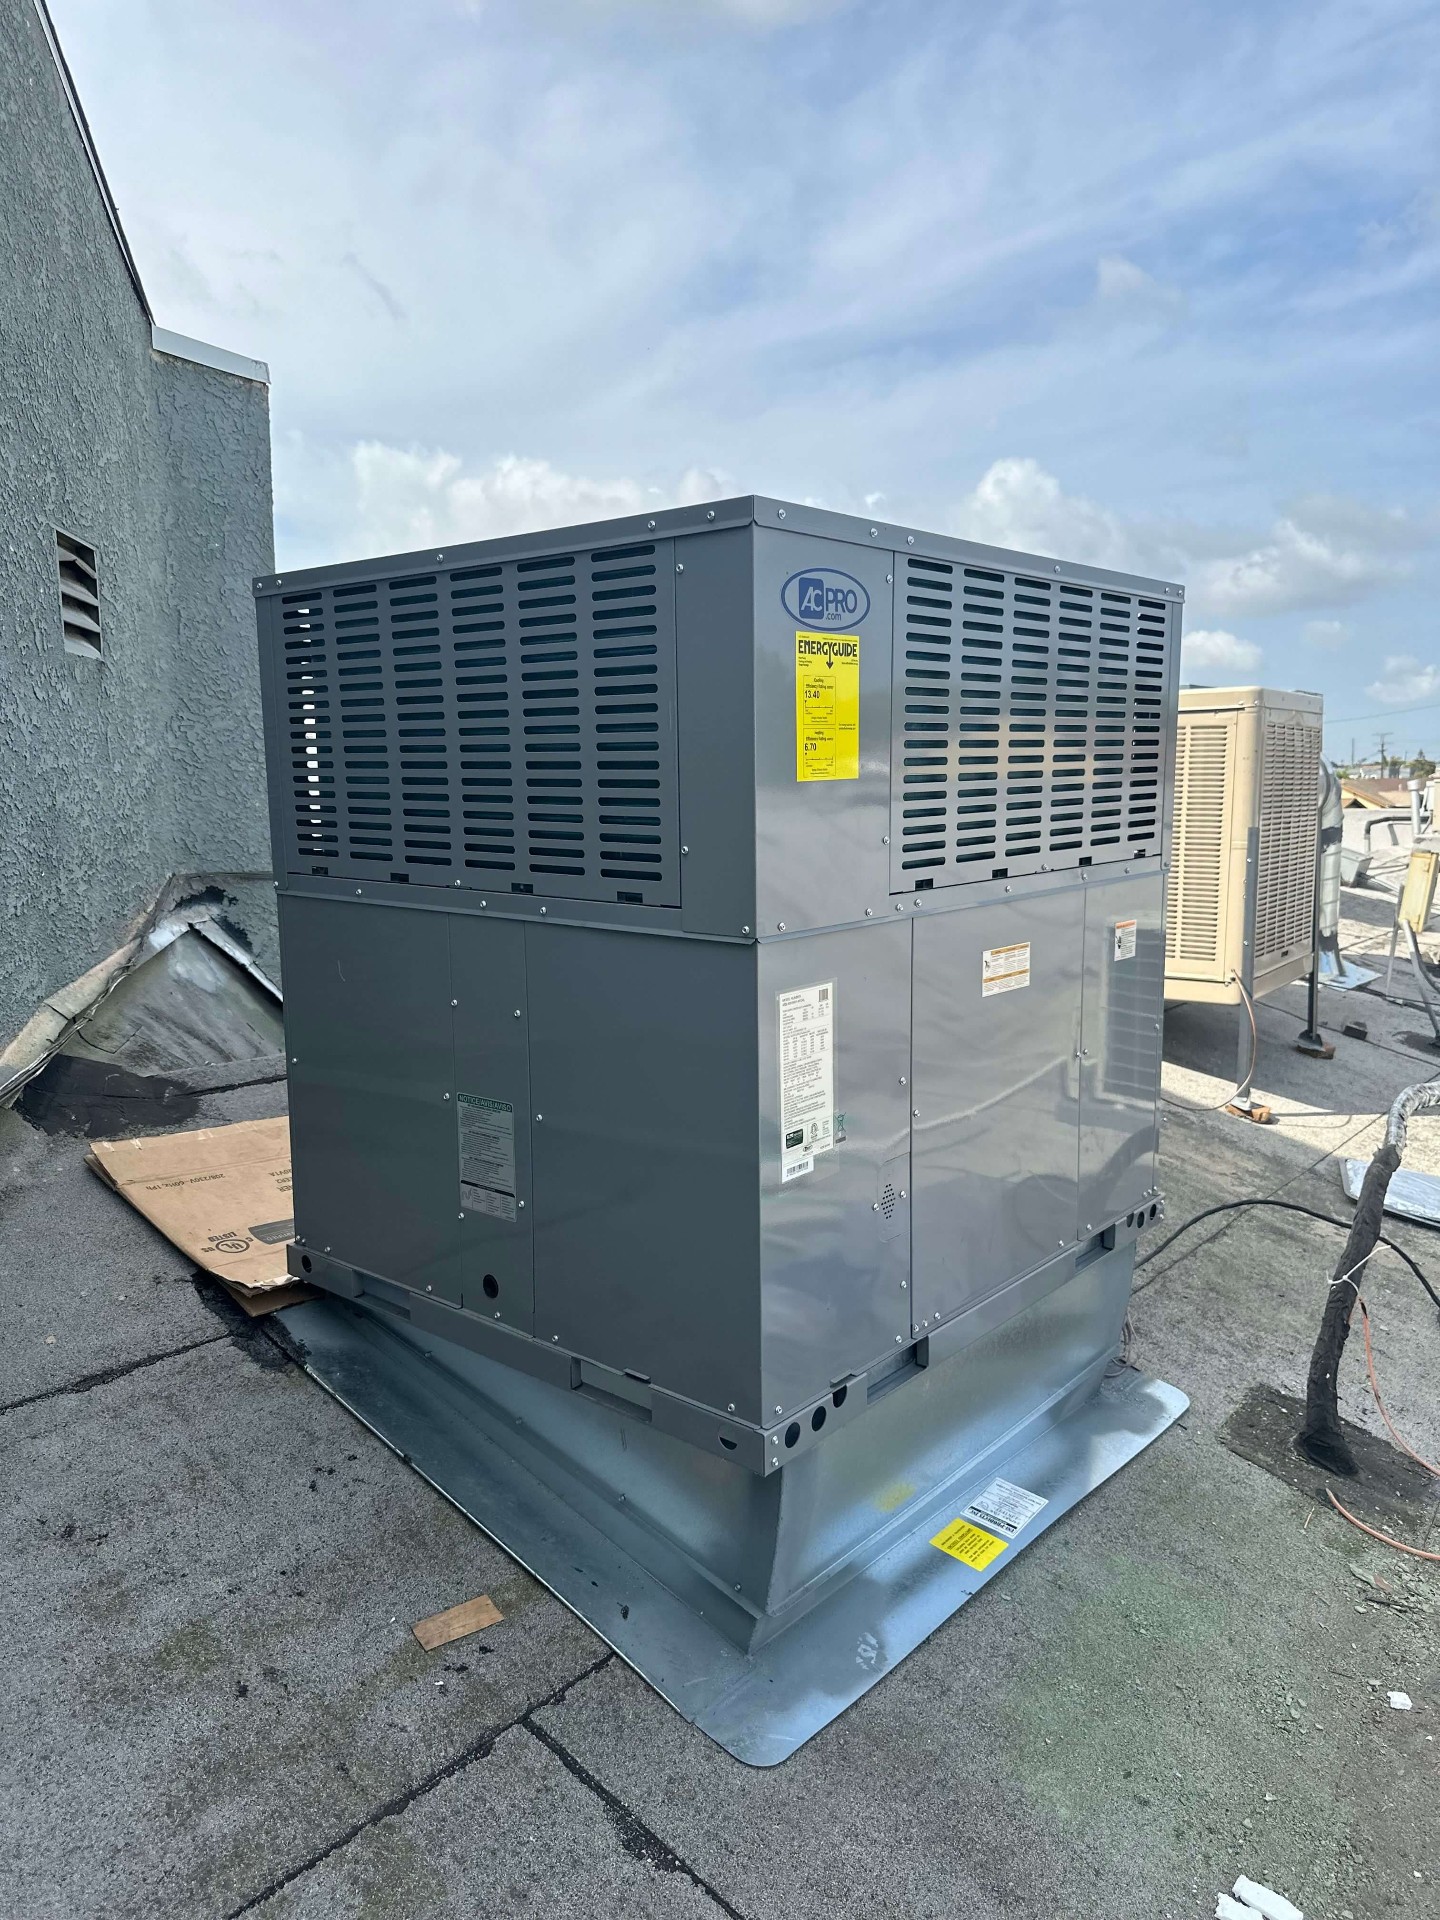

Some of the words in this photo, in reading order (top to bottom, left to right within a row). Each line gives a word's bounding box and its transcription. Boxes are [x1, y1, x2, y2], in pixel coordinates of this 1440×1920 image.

[801, 586, 823, 612] AC
[825, 587, 858, 614] PRO
[825, 612, 842, 621] .com
[798, 639, 858, 658] ENERGYGUIDE
[804, 690, 820, 699] 13.40
[804, 742, 817, 751] 6.70
[207, 1231, 238, 1243] LISTED
